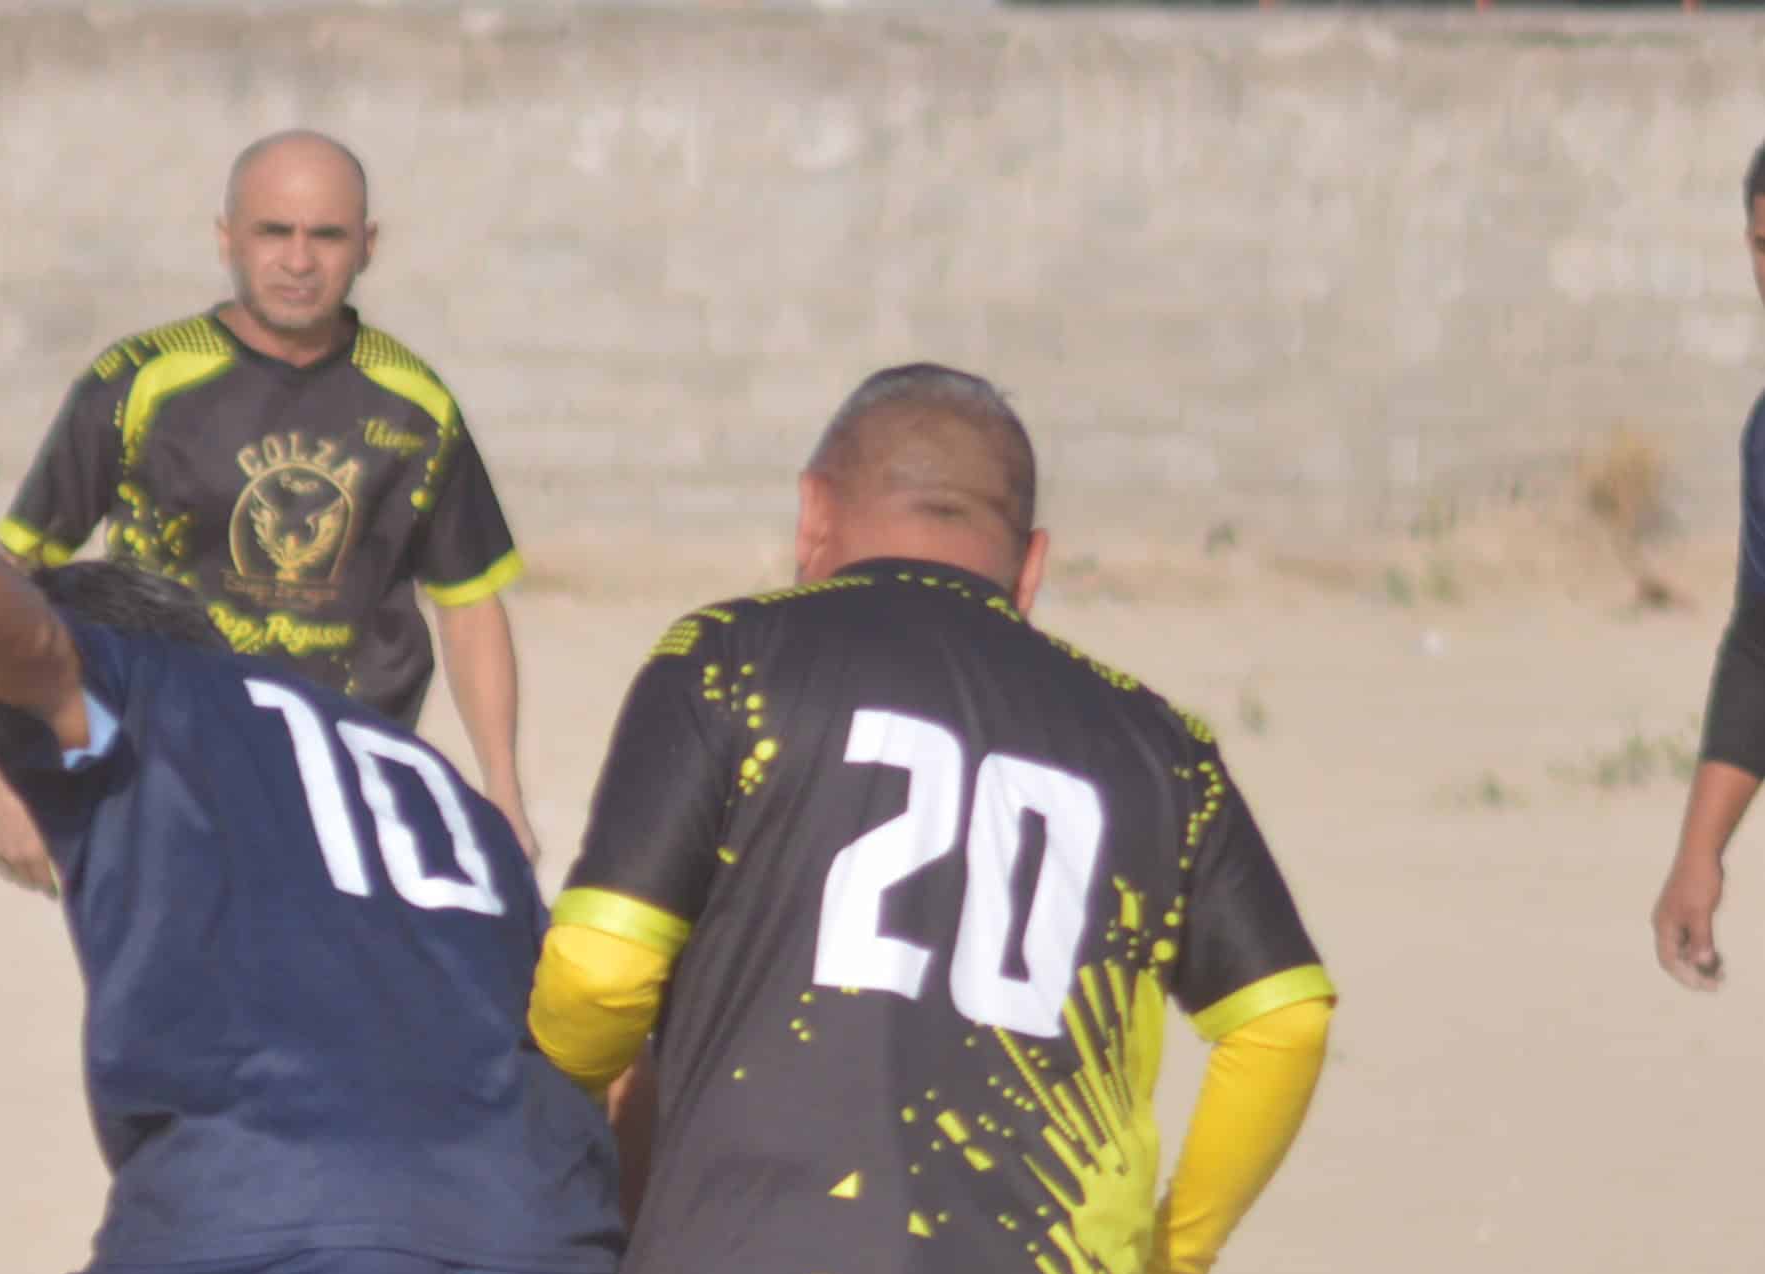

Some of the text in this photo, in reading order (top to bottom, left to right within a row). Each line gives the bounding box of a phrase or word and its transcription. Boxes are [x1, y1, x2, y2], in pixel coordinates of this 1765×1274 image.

[236, 432, 362, 488] COLZA
[242, 678, 505, 916] 10
[811, 708, 1105, 1039] 20
